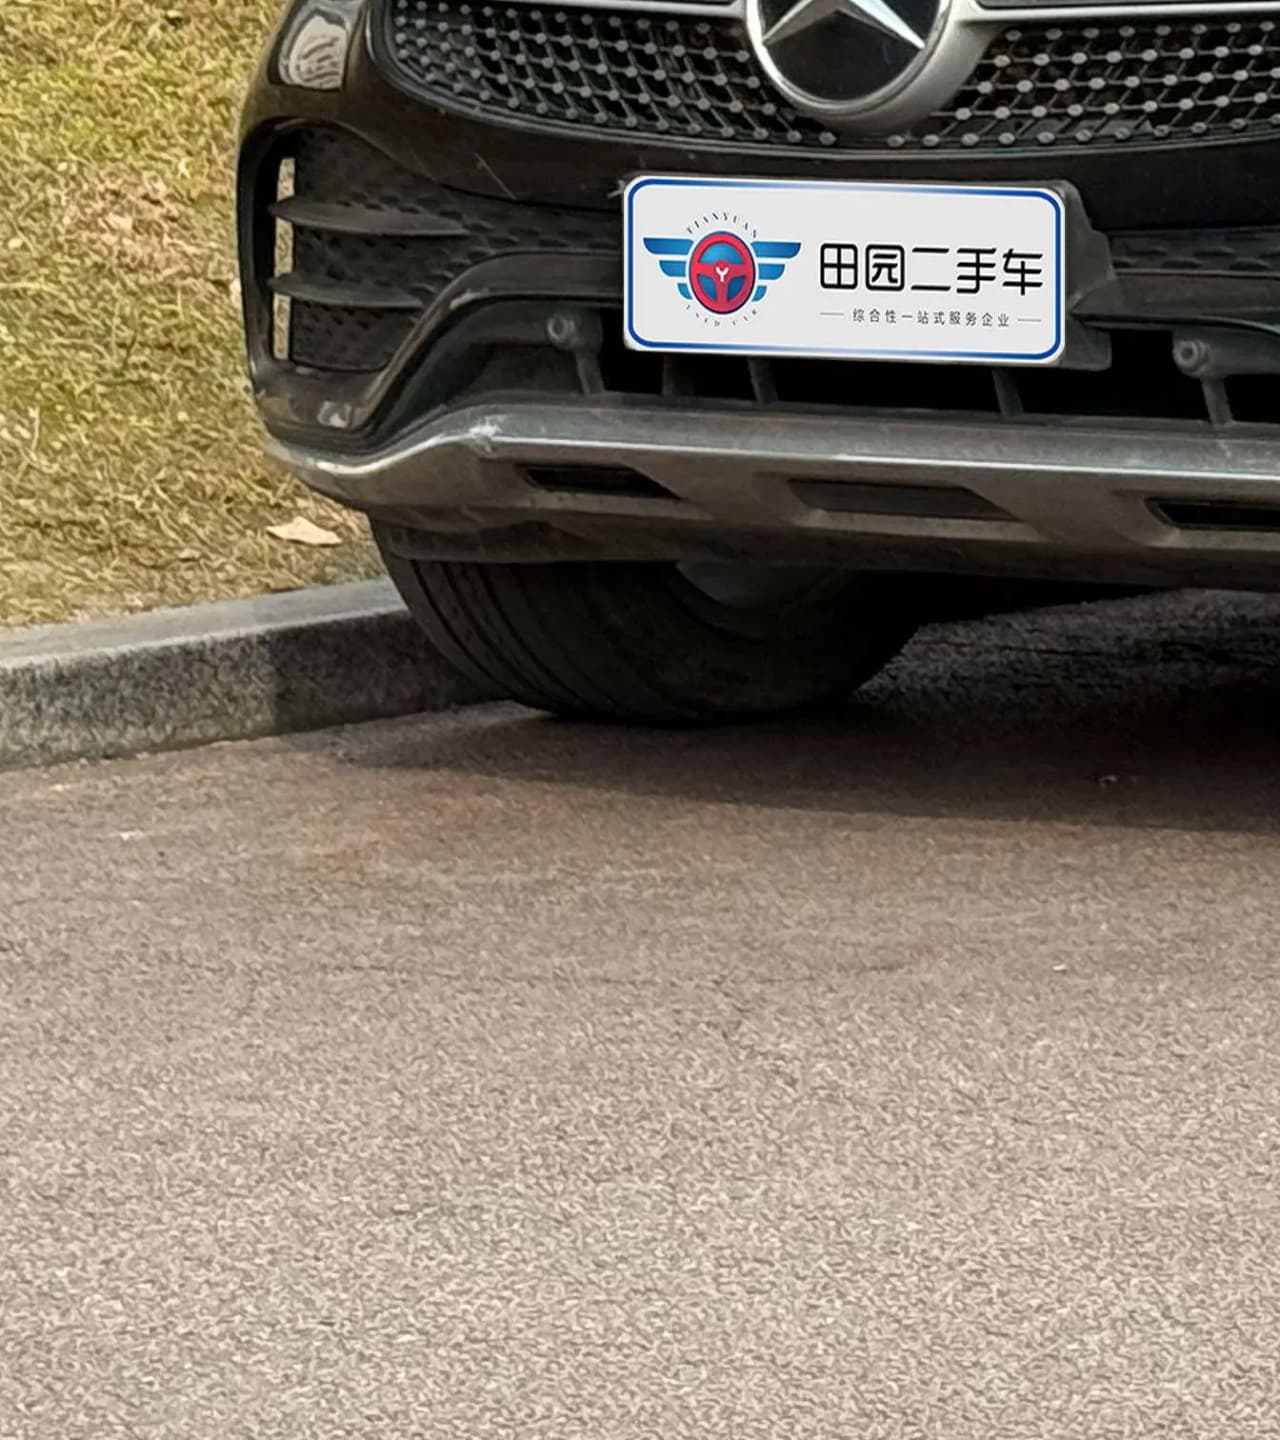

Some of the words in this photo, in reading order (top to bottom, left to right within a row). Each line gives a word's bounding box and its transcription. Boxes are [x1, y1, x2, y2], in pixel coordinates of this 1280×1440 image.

[820, 242, 1043, 296] 田园二手车
[852, 307, 1010, 328] 综合性一站式服务企业
